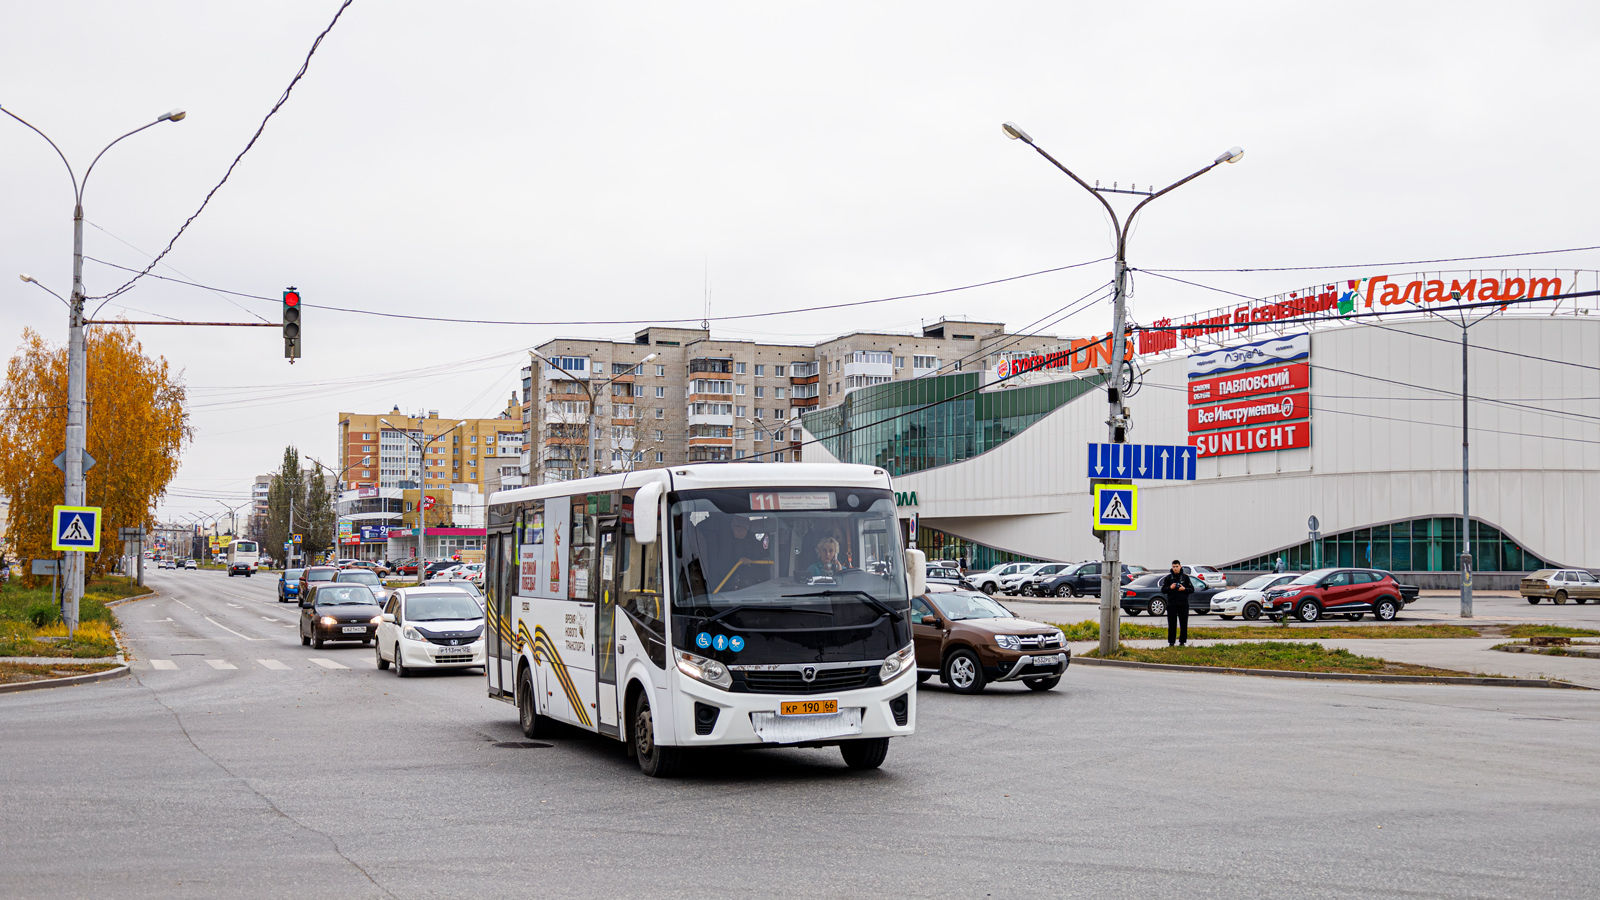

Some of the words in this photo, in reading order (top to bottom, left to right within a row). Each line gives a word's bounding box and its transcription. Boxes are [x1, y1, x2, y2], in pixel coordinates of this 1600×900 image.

[1365, 275, 1562, 311] Галамарт
[1180, 313, 1231, 340] МАГНИТ
[1250, 285, 1338, 323] СЕМЕЙНЫЙ
[1011, 354, 1044, 376] БУРГЕР
[1045, 349, 1071, 369] КИНГ
[1219, 368, 1290, 396] ПАВЛОВСКИЙ
[1197, 425, 1296, 455] SUNLIGHT
[756, 494, 775, 510] 11
[565, 614, 576, 624] ВРЕМЯ
[565, 627, 578, 638] НОВОГО
[565, 640, 586, 652] ТРАНСПОРТА
[802, 702, 820, 713] 190
